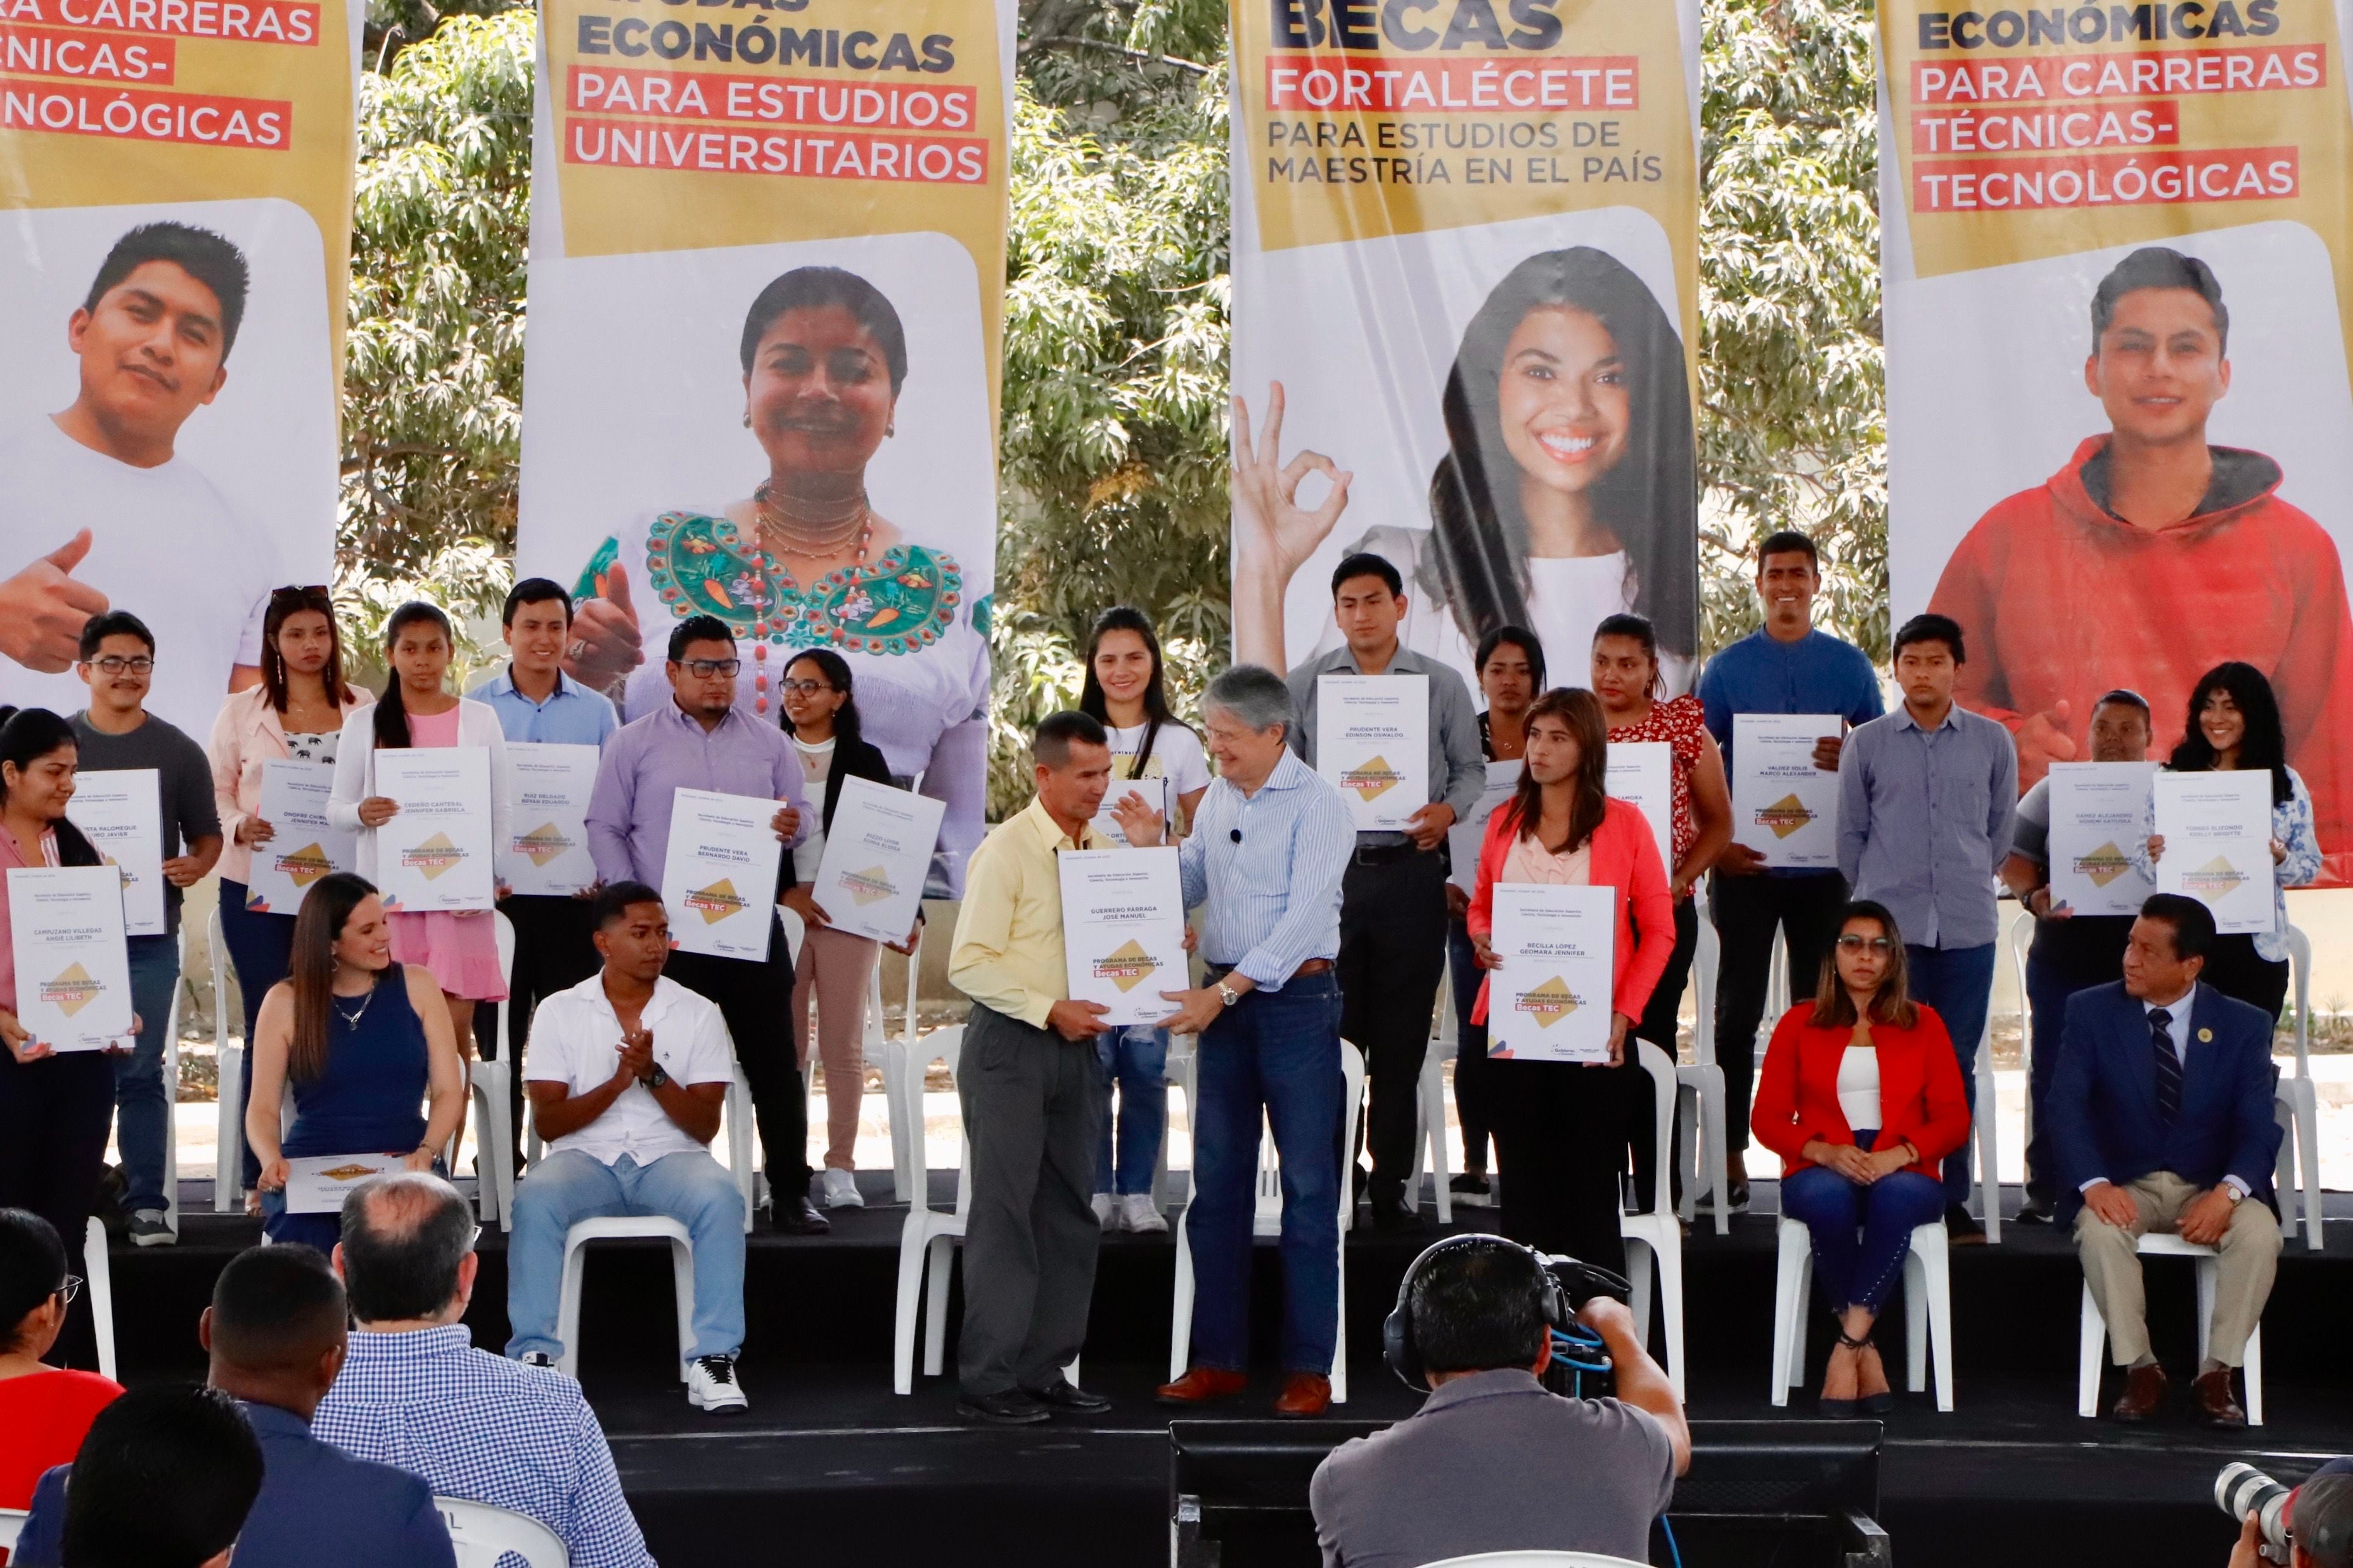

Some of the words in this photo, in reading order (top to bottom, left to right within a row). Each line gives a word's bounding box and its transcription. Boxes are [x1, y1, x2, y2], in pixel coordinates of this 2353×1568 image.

[60, 0, 313, 42] CARRERAS
[1271, 0, 1563, 52] BECAS
[1918, 0, 2280, 49] ECONÓMICAS
[0, 35, 168, 80] NICAS-
[578, 15, 955, 73] ECONÓMICAS
[1271, 61, 1634, 107] FORTALÉCETE
[1920, 64, 2045, 101] PARA
[2061, 52, 2319, 94] CARRERAS
[4, 91, 281, 145] NOLÓGICAS
[577, 73, 708, 115] PARA
[727, 82, 969, 129] ESTUDIOS
[1268, 121, 1366, 148] PARA
[1378, 121, 1558, 149] ESTUDIOS
[1572, 121, 1620, 147] DE
[1920, 110, 2173, 151] TÉCNICAS-
[575, 126, 983, 182] UNIVERSITARIOS
[1268, 151, 1451, 184] MAESTRÍA
[1465, 158, 1512, 184] EN
[1527, 156, 1569, 183] EL
[1584, 150, 1662, 182] PAÍS
[1921, 159, 2294, 207] TECNOLÓGICAS
[698, 851, 731, 860] BERNARDO
[700, 845, 730, 854] PRUDENTE
[1120, 968, 1138, 976] TEC
[1516, 1004, 1541, 1012] Becas
[1542, 1004, 1560, 1012] TEC
